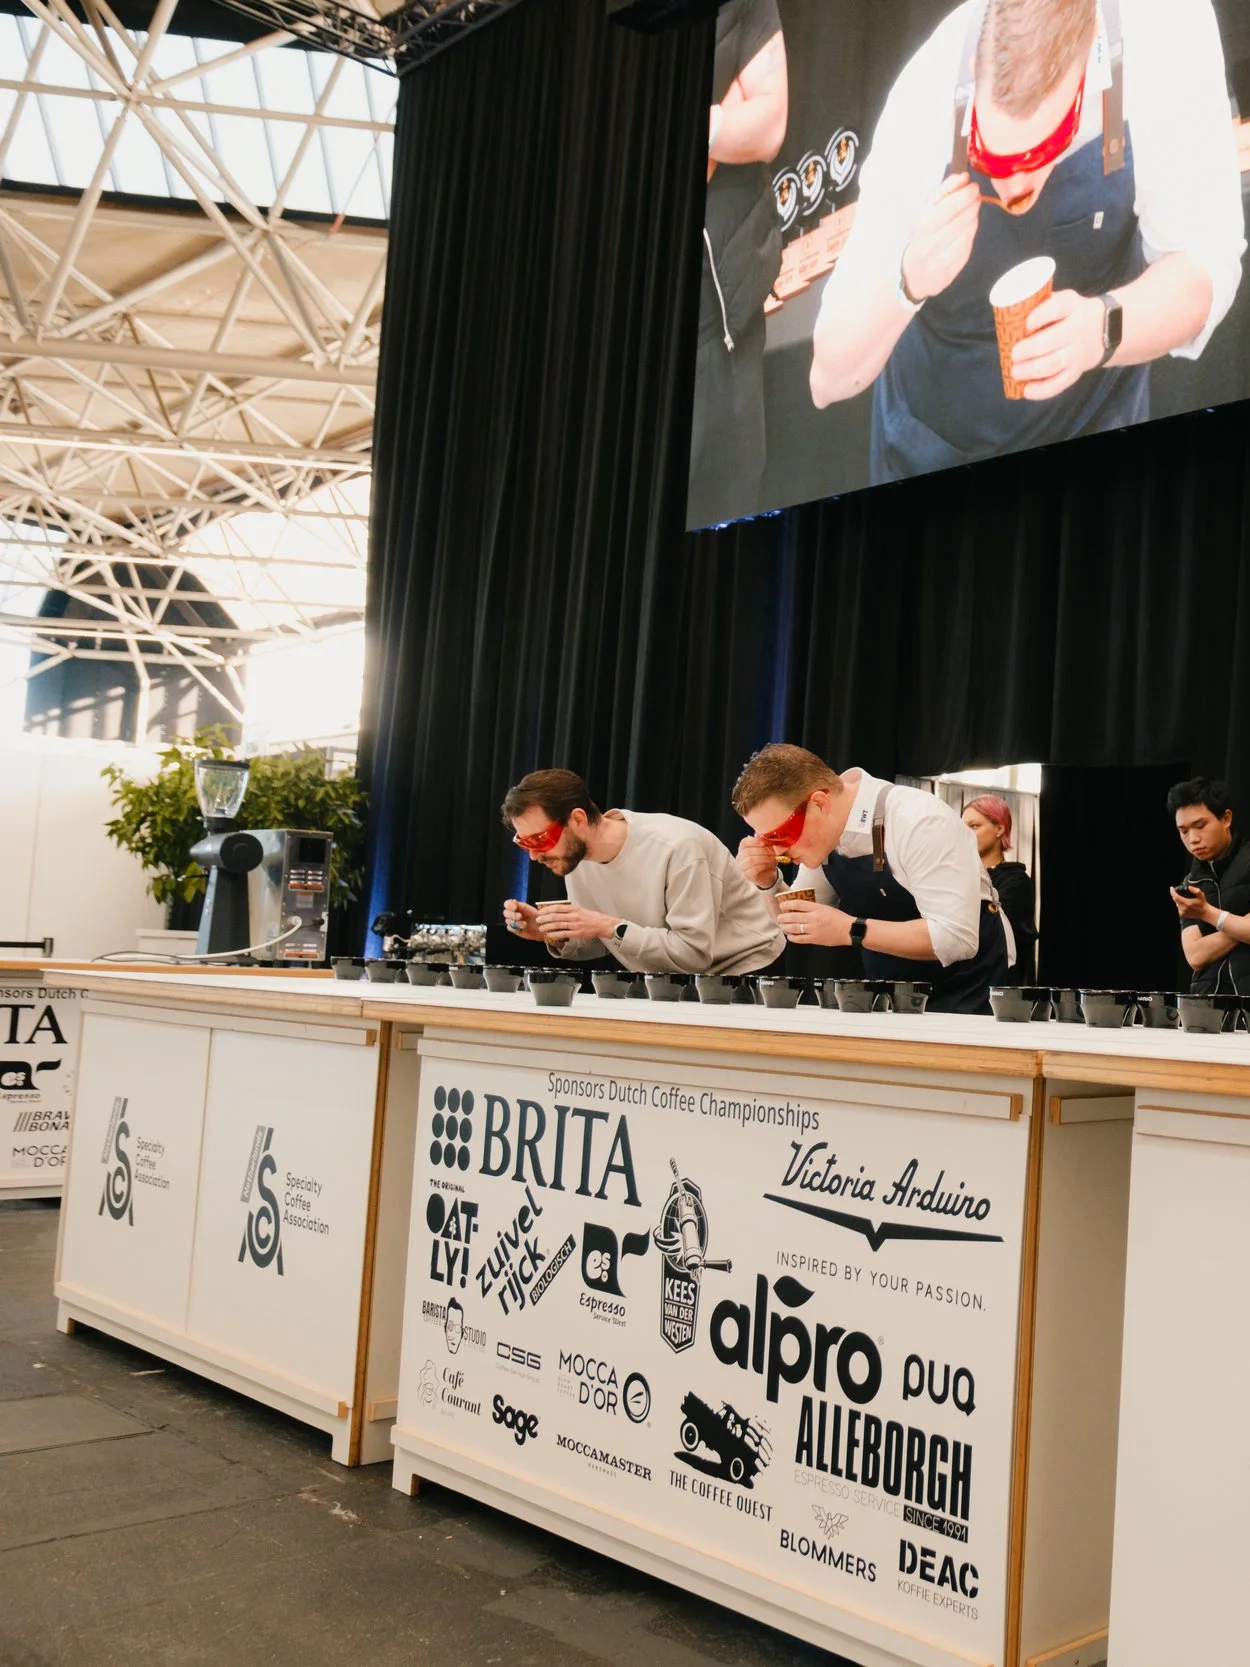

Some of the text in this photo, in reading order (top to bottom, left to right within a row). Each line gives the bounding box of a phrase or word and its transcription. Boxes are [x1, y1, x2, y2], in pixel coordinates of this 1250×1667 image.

[38, 987, 76, 999] Dutch
[548, 1072, 820, 1135] Sponsors Dutch Coffee Championships
[479, 1093, 642, 1207] BRITA
[286, 1172, 322, 1197] Specialty
[430, 1179, 465, 1193] THE ORIGINAL
[781, 1140, 991, 1221] Victoria Arduino
[284, 1191, 311, 1212] Coffee
[283, 1209, 330, 1235] Association
[476, 1185, 543, 1299] zuivel
[430, 1239, 470, 1289] LY!
[498, 1236, 546, 1316] rijck
[531, 1241, 573, 1302] BIOLOGISCH
[776, 1250, 987, 1312] INSPIRED BY YOUR PASSION.
[422, 1300, 447, 1320] BARISTA
[580, 1293, 626, 1317] Espresso
[665, 1277, 696, 1305] KEES
[664, 1303, 693, 1321] VAN DER
[664, 1320, 692, 1344] WESTEN
[463, 1325, 487, 1347] STUDIO
[709, 1273, 883, 1404] alpro
[559, 1349, 618, 1389] MOCCA
[441, 1387, 481, 1416] Courant
[579, 1381, 618, 1416] D'OR
[492, 1394, 539, 1445] Sage
[556, 1434, 652, 1481] MOCCAMASTER
[795, 1395, 973, 1521] ALLEBORGH
[669, 1470, 688, 1491] THE
[691, 1478, 732, 1508] COFFEE
[794, 1469, 900, 1518] ESPRESSO SERVICE
[905, 1506, 967, 1542] SINCE 1991
[780, 1529, 877, 1583] BLOMMERS
[899, 1539, 979, 1599] DEAC
[897, 1579, 979, 1620] KOFFIE EXPERTS
